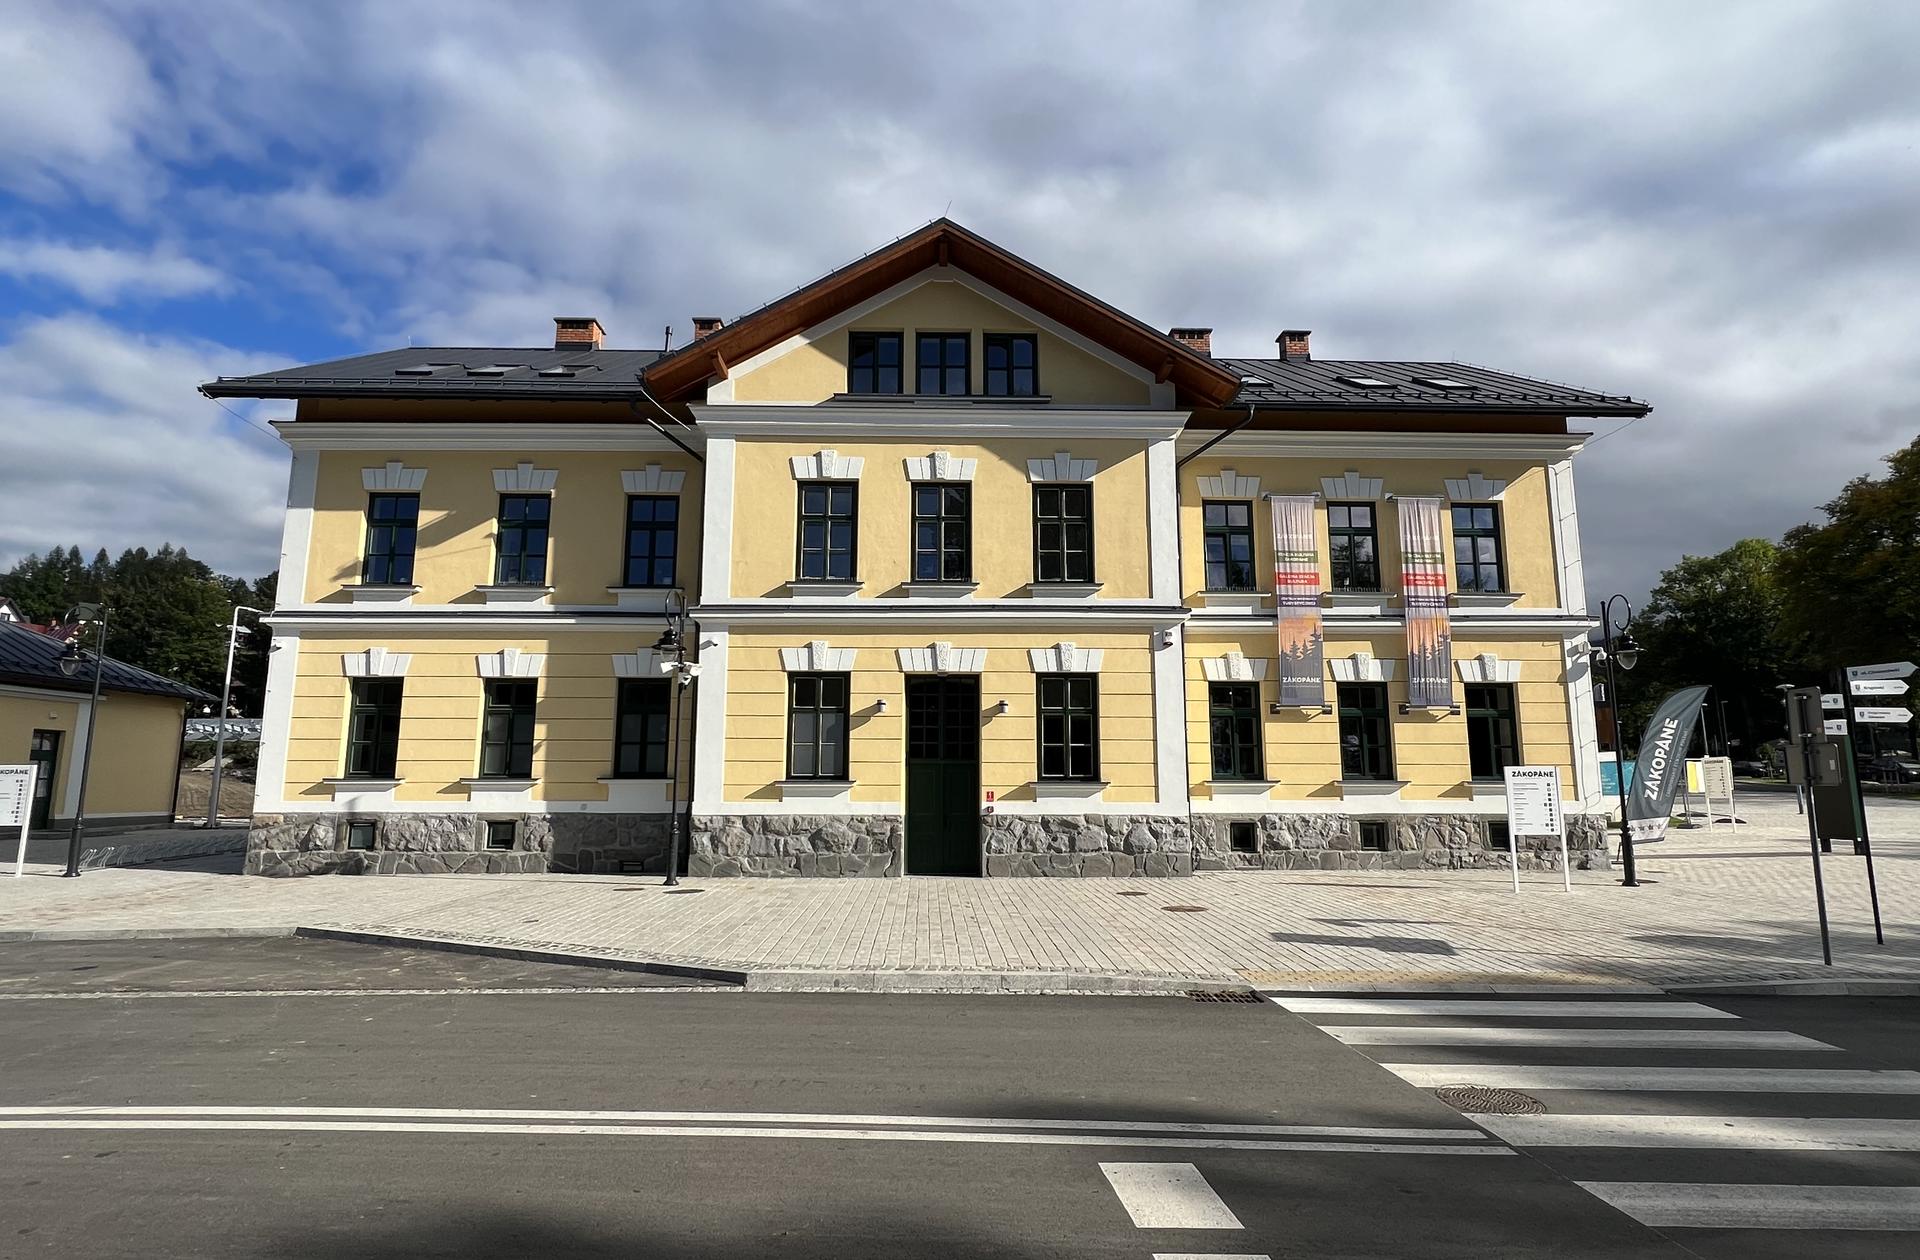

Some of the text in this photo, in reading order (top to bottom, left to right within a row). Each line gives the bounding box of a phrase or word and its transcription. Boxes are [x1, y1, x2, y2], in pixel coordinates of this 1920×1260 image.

[1282, 675, 1321, 683] ZAKOPANE
[1644, 717, 1679, 801] ZAKOPANE
[1511, 770, 1554, 778] ZAKOPANE
